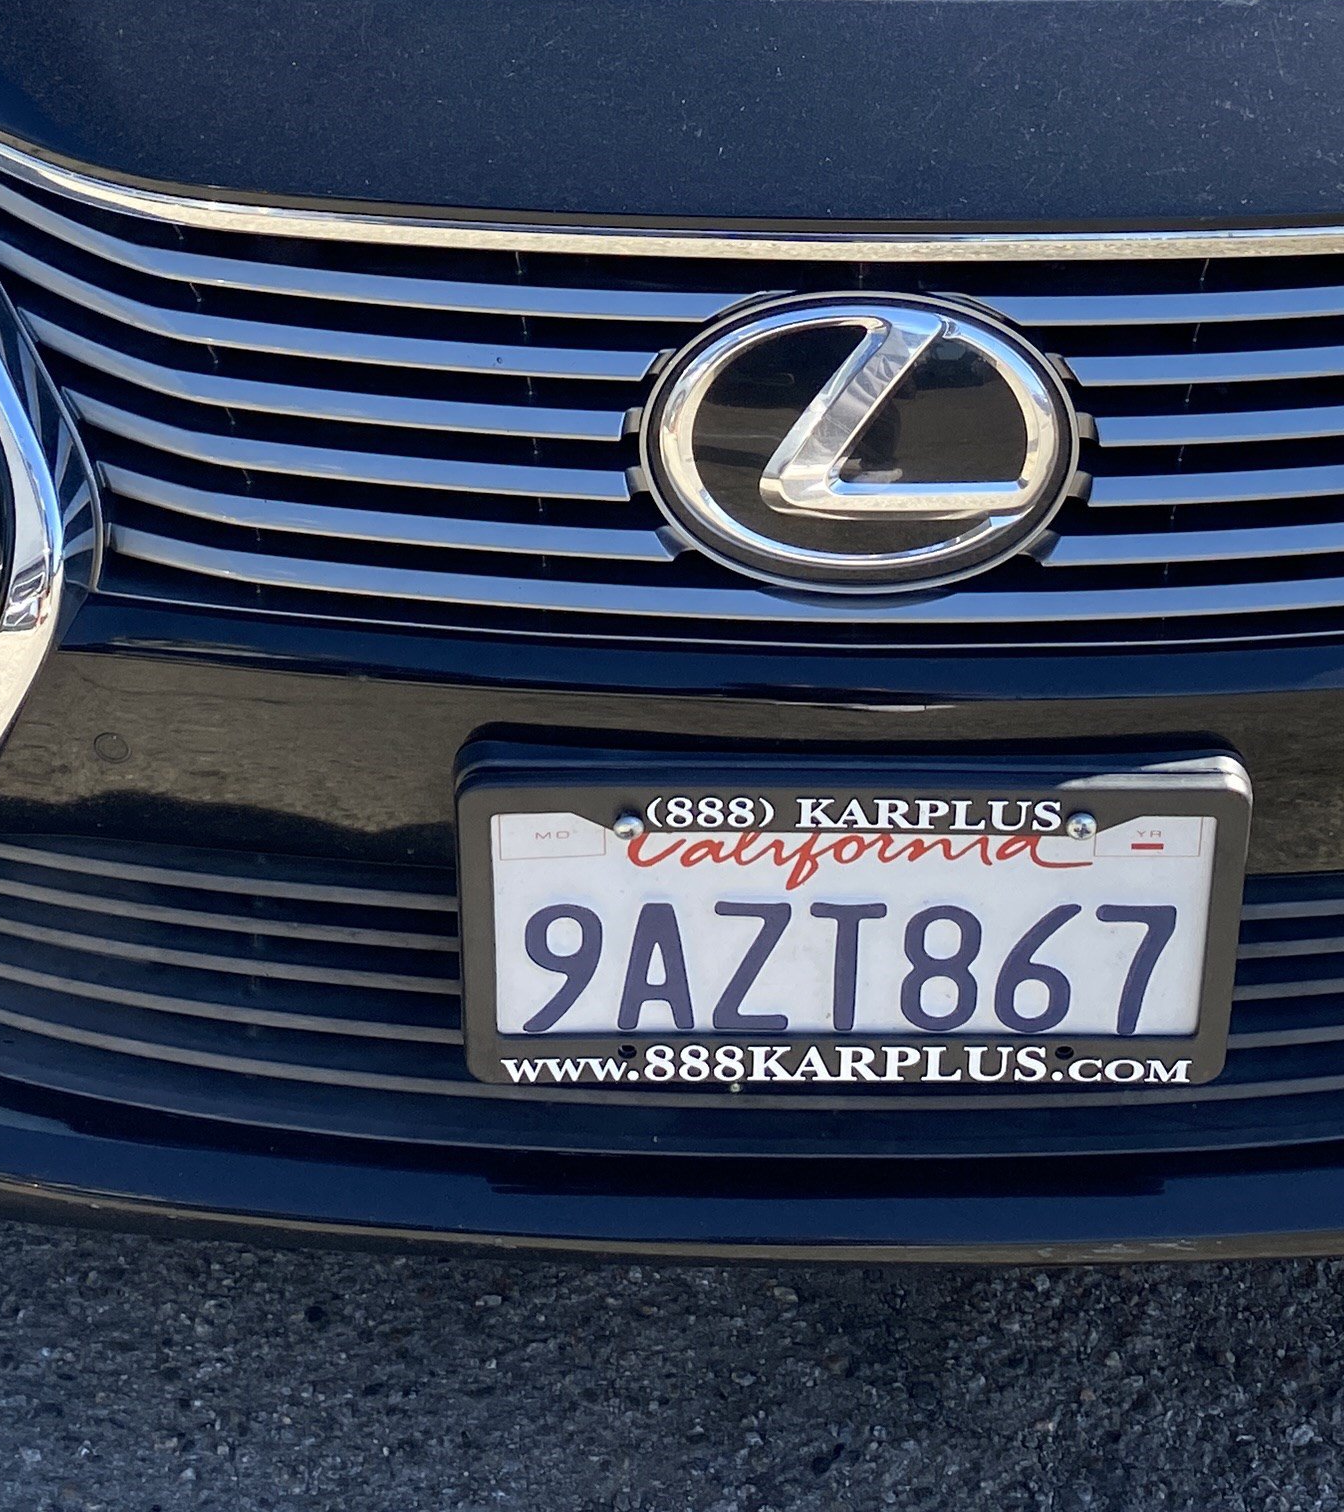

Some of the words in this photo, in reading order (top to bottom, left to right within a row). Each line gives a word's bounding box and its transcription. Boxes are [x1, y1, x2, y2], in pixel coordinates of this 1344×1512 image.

[645, 797, 776, 830] (888)
[795, 797, 1062, 831] KARPLUS
[535, 830, 570, 840] MO
[1137, 829, 1162, 838] YR
[521, 901, 1178, 1036] 9AZT867
